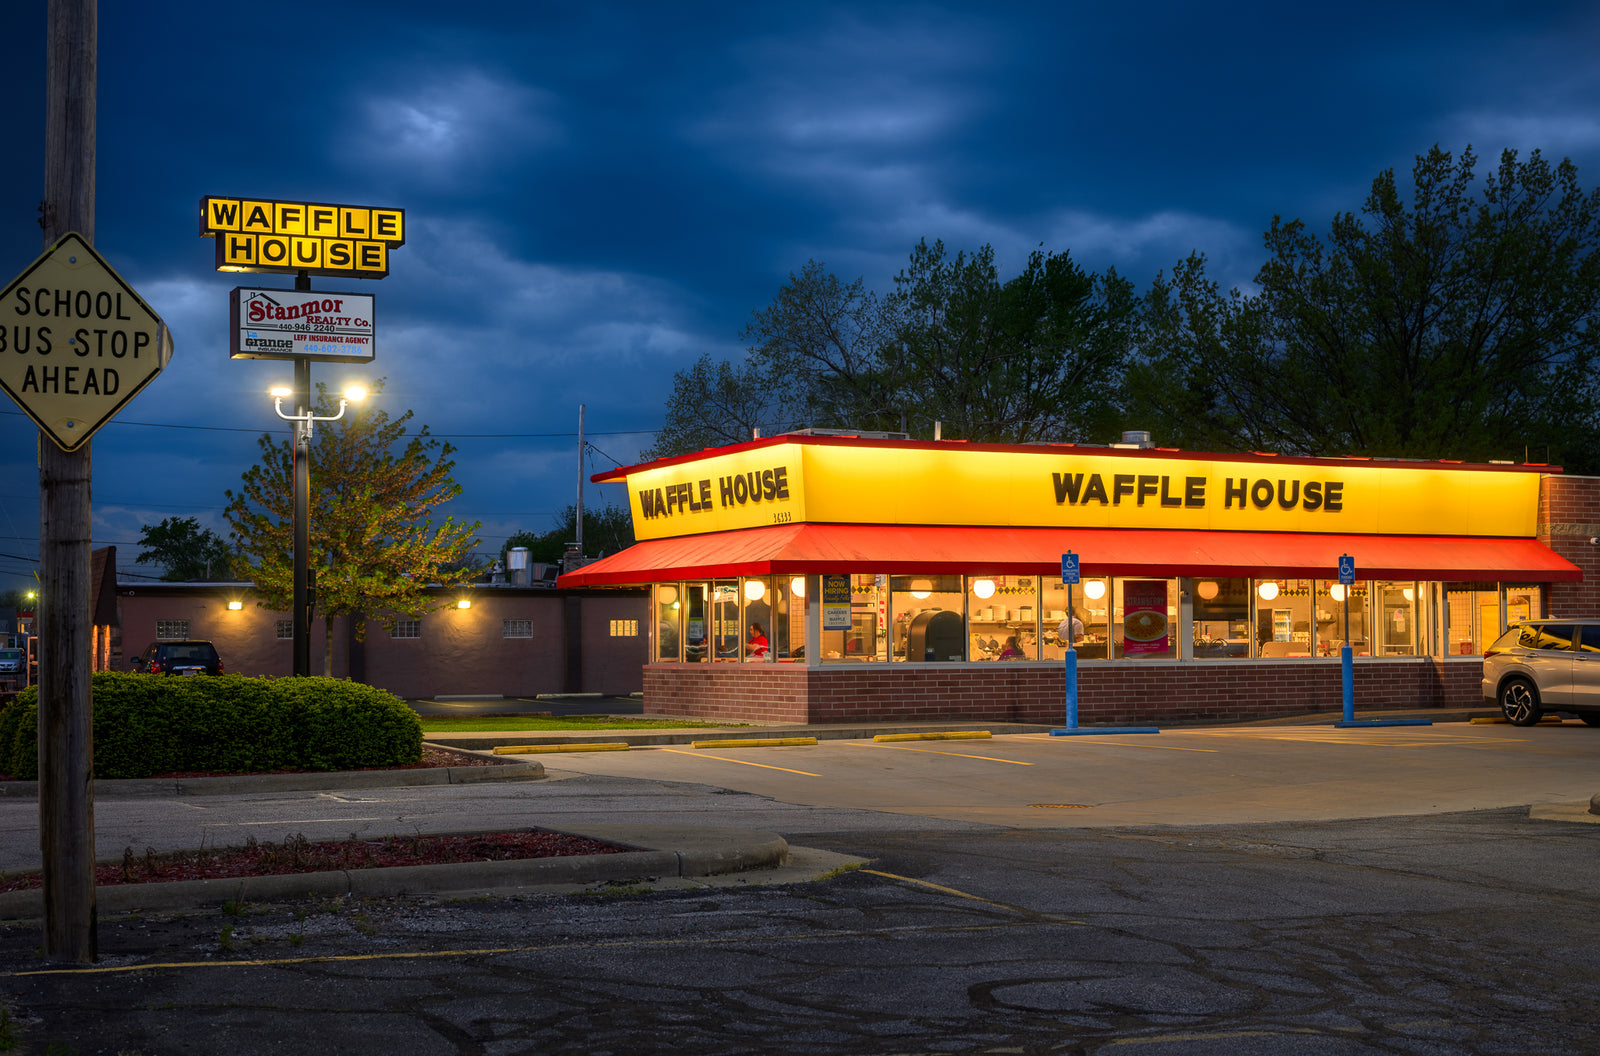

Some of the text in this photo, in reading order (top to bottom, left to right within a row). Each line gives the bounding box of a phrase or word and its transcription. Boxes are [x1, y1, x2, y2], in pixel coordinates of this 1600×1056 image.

[213, 203, 397, 236] WAFFLE
[231, 237, 381, 267] HOUSE
[14, 286, 131, 321] SCHOOL
[249, 299, 343, 321] Stanmor
[306, 316, 371, 328] REALTY Co.
[313, 324, 335, 333] 2240
[73, 328, 150, 359] STOP
[304, 344, 362, 354] 440-602-3786
[309, 334, 343, 343] INSURANCE
[21, 365, 120, 396] AHEAD
[639, 466, 790, 518] WAFFLE HOUSE
[1052, 473, 1344, 511] WAFFLE HOUSE
[824, 587, 849, 595] HIRING
[828, 580, 845, 588] NOW
